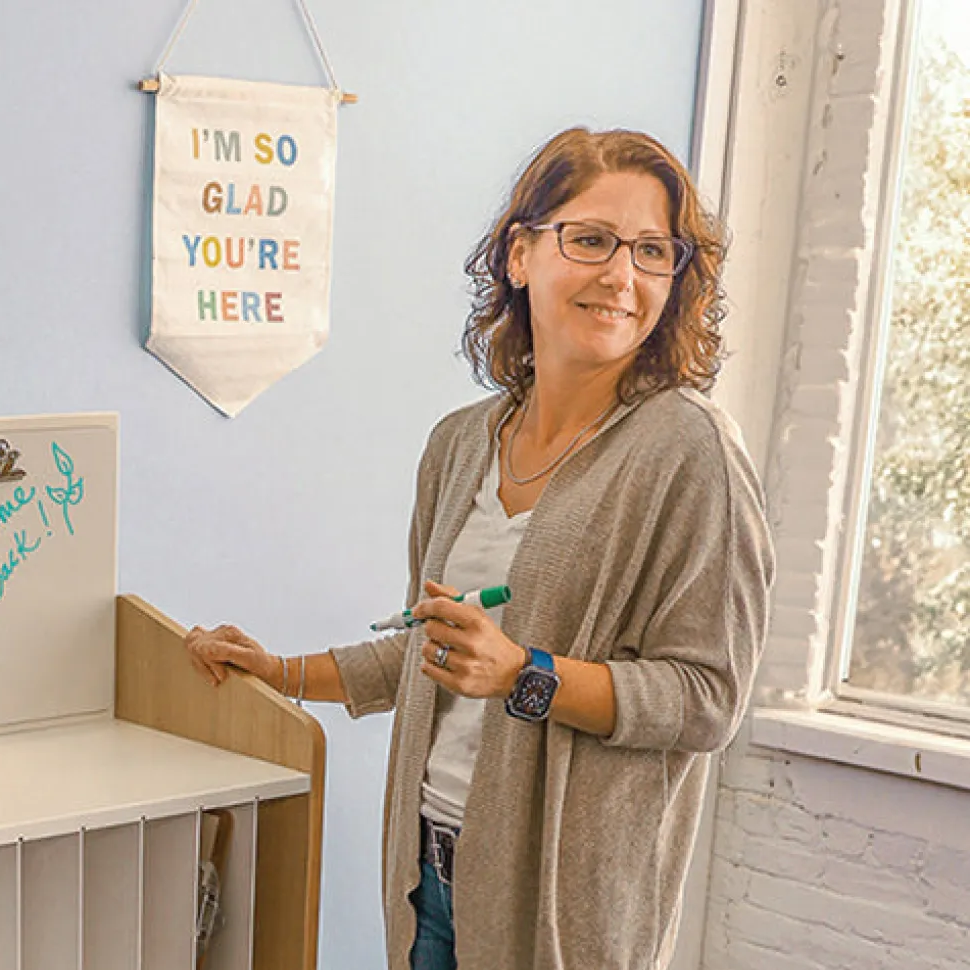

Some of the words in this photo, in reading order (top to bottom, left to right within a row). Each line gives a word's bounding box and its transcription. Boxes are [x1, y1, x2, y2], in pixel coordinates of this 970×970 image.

[191, 128, 241, 162] I'M
[254, 133, 298, 167] SO
[202, 181, 288, 217] GLAD
[182, 235, 301, 271] YOU'RE
[198, 290, 284, 323] HERE
